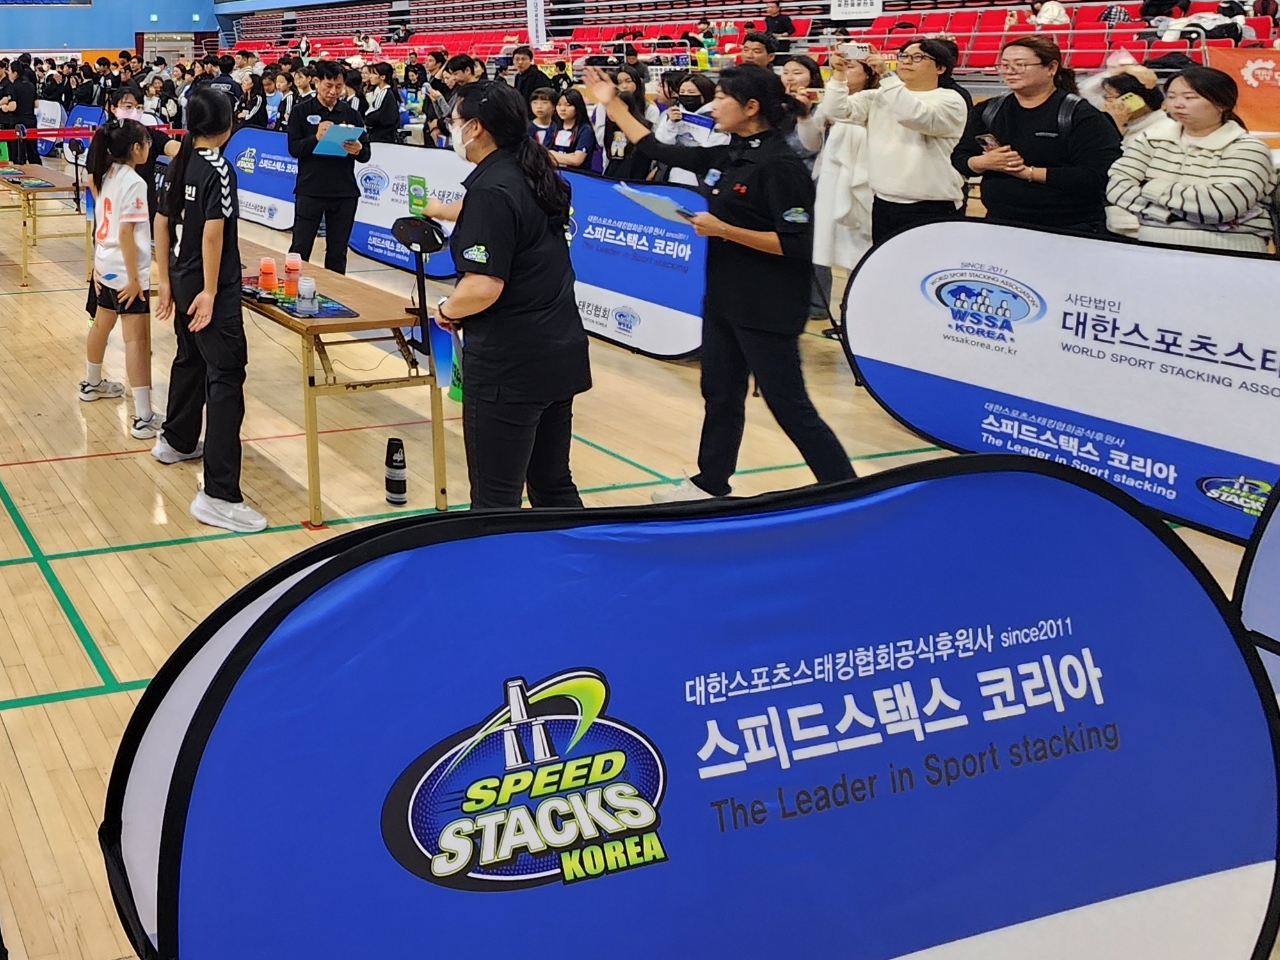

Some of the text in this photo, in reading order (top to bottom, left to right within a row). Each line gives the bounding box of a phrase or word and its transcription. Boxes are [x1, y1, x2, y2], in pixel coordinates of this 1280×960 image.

[582, 224, 692, 262] 스피드스택스 코리아
[930, 274, 949, 286] WORLD
[968, 272, 999, 283] STACKING
[960, 262, 1009, 275] SINCE 2011
[950, 307, 1014, 334] WSSA
[1065, 293, 1121, 314] 사단법인
[943, 333, 1018, 356] wssakorea.or.kr
[955, 323, 1008, 343] KOREA
[1061, 342, 1106, 360] WORLD
[1110, 353, 1155, 371] SPORT
[1159, 363, 1233, 388] STACKING
[984, 401, 1126, 447] 대한스포츠스태킹협회공식후원사
[981, 414, 1178, 485] 스피드스택스 코리아
[981, 432, 1177, 500] The Leader in Sport stacking
[1206, 489, 1265, 511] STACK
[684, 616, 1074, 707] 대한스포츠스태킹협회공식후원사 since2011
[697, 647, 1105, 780] 스피드스택스 코리아
[462, 750, 626, 813] SPEED
[710, 722, 1120, 834] The Leader in Sport stacking
[431, 782, 657, 878] STACKS
[560, 832, 666, 881] KOREA
